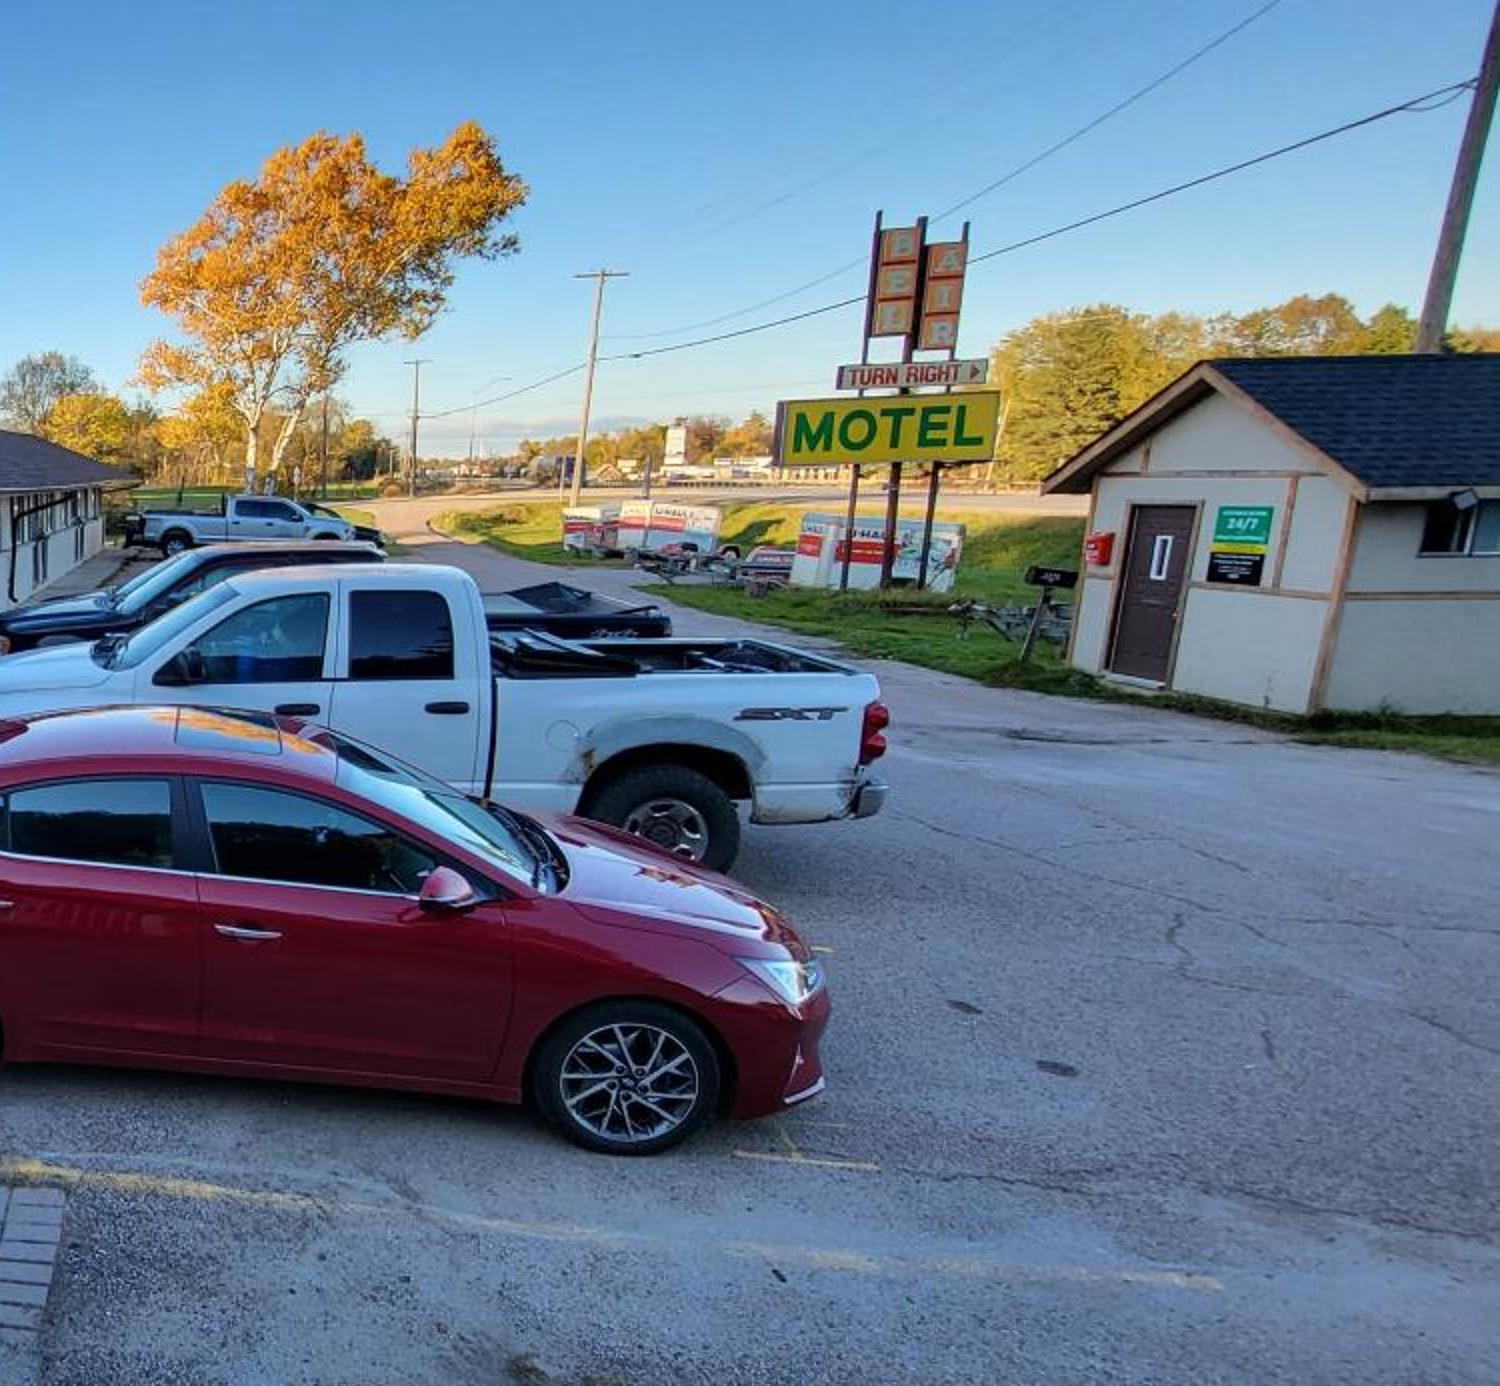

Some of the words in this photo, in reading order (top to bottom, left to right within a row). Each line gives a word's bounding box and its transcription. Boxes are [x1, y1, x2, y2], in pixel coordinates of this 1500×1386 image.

[849, 368, 899, 387] TURN
[906, 364, 962, 383] RIGHT
[792, 405, 984, 453] MOTEL
[1227, 517, 1259, 529] 24/7
